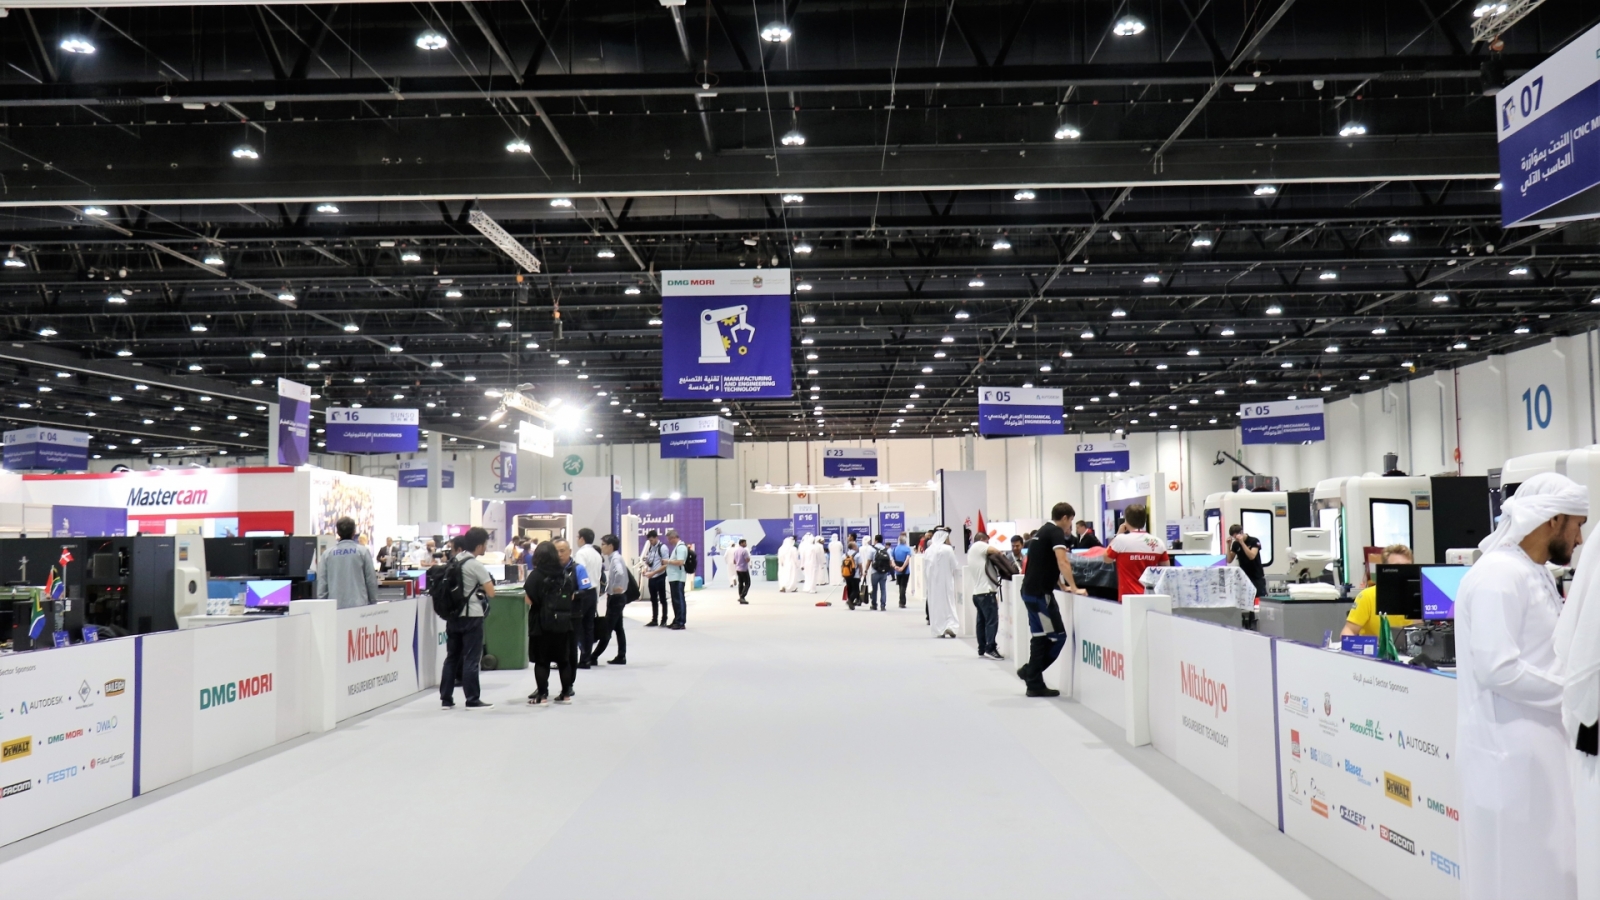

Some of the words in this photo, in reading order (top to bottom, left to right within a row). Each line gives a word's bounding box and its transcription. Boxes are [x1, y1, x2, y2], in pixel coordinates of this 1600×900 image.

[1521, 75, 1544, 118] 07
[1573, 121, 1590, 140] CNC
[996, 391, 1011, 402] 05
[1255, 405, 1270, 416] 05
[1522, 384, 1553, 430] 10
[344, 411, 360, 422] 16
[670, 421, 680, 432] 16
[47, 432, 57, 442] 04
[834, 449, 844, 457] 23
[1084, 443, 1093, 452] 23
[127, 487, 209, 506] Mastercam
[891, 512, 900, 520] 05
[333, 548, 357, 556] IRAN
[1129, 554, 1156, 562] BELARUS
[348, 624, 398, 664] Mitutoyo
[1083, 639, 1102, 670] DMG
[1102, 646, 1125, 681] MOR
[15, 665, 37, 675] Sponsors
[347, 677, 376, 696] MEASUREMENT
[376, 670, 399, 688] TECHNOLOGY
[1180, 660, 1228, 719] Mitutoyo
[1389, 680, 1409, 694] Sponsors
[200, 682, 237, 711] DMG
[238, 672, 273, 700] MORI
[29, 696, 64, 711] AUTODESK
[47, 733, 66, 745] DMG
[65, 728, 85, 740] MORI
[1349, 722, 1374, 738] PRODUCTS
[1406, 735, 1441, 758] AUTODESK
[46, 765, 78, 784] FESTO
[1427, 797, 1446, 815] DMG
[1445, 805, 1460, 822] MO
[1430, 850, 1461, 881] FEST
